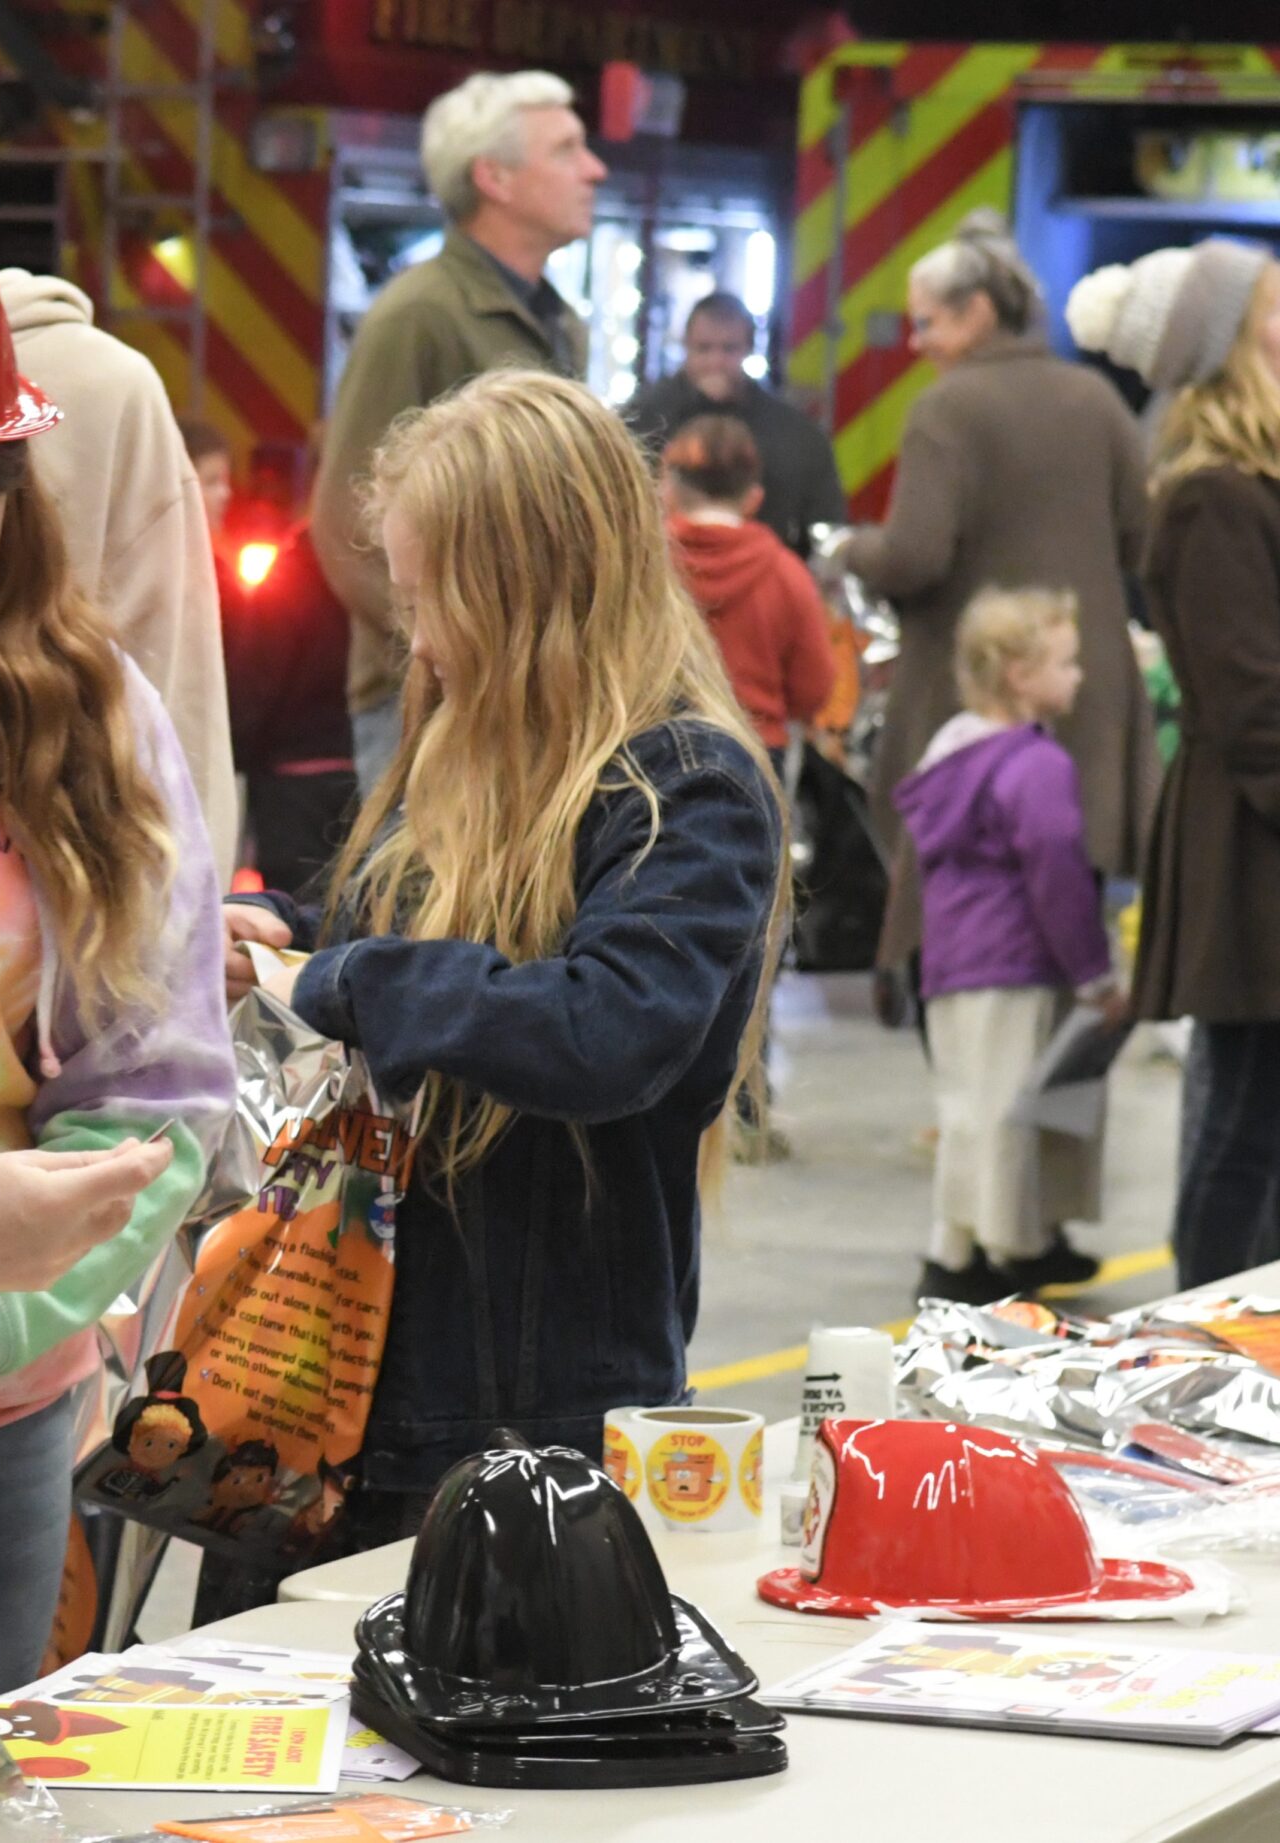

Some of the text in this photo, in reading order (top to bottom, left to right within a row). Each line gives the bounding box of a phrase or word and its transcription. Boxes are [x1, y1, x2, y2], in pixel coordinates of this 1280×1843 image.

[260, 1289, 280, 1304] out
[238, 1310, 287, 1333] costume
[209, 1348, 222, 1359] or
[225, 1353, 250, 1369] with
[251, 1361, 281, 1379] other
[247, 1340, 297, 1365] powered
[212, 1371, 241, 1394] Don't
[242, 1386, 260, 1401] eat
[671, 1433, 707, 1447] STOP
[239, 1716, 284, 1778] FIRE SAFETY
[285, 1745, 304, 1763] ABOUT
